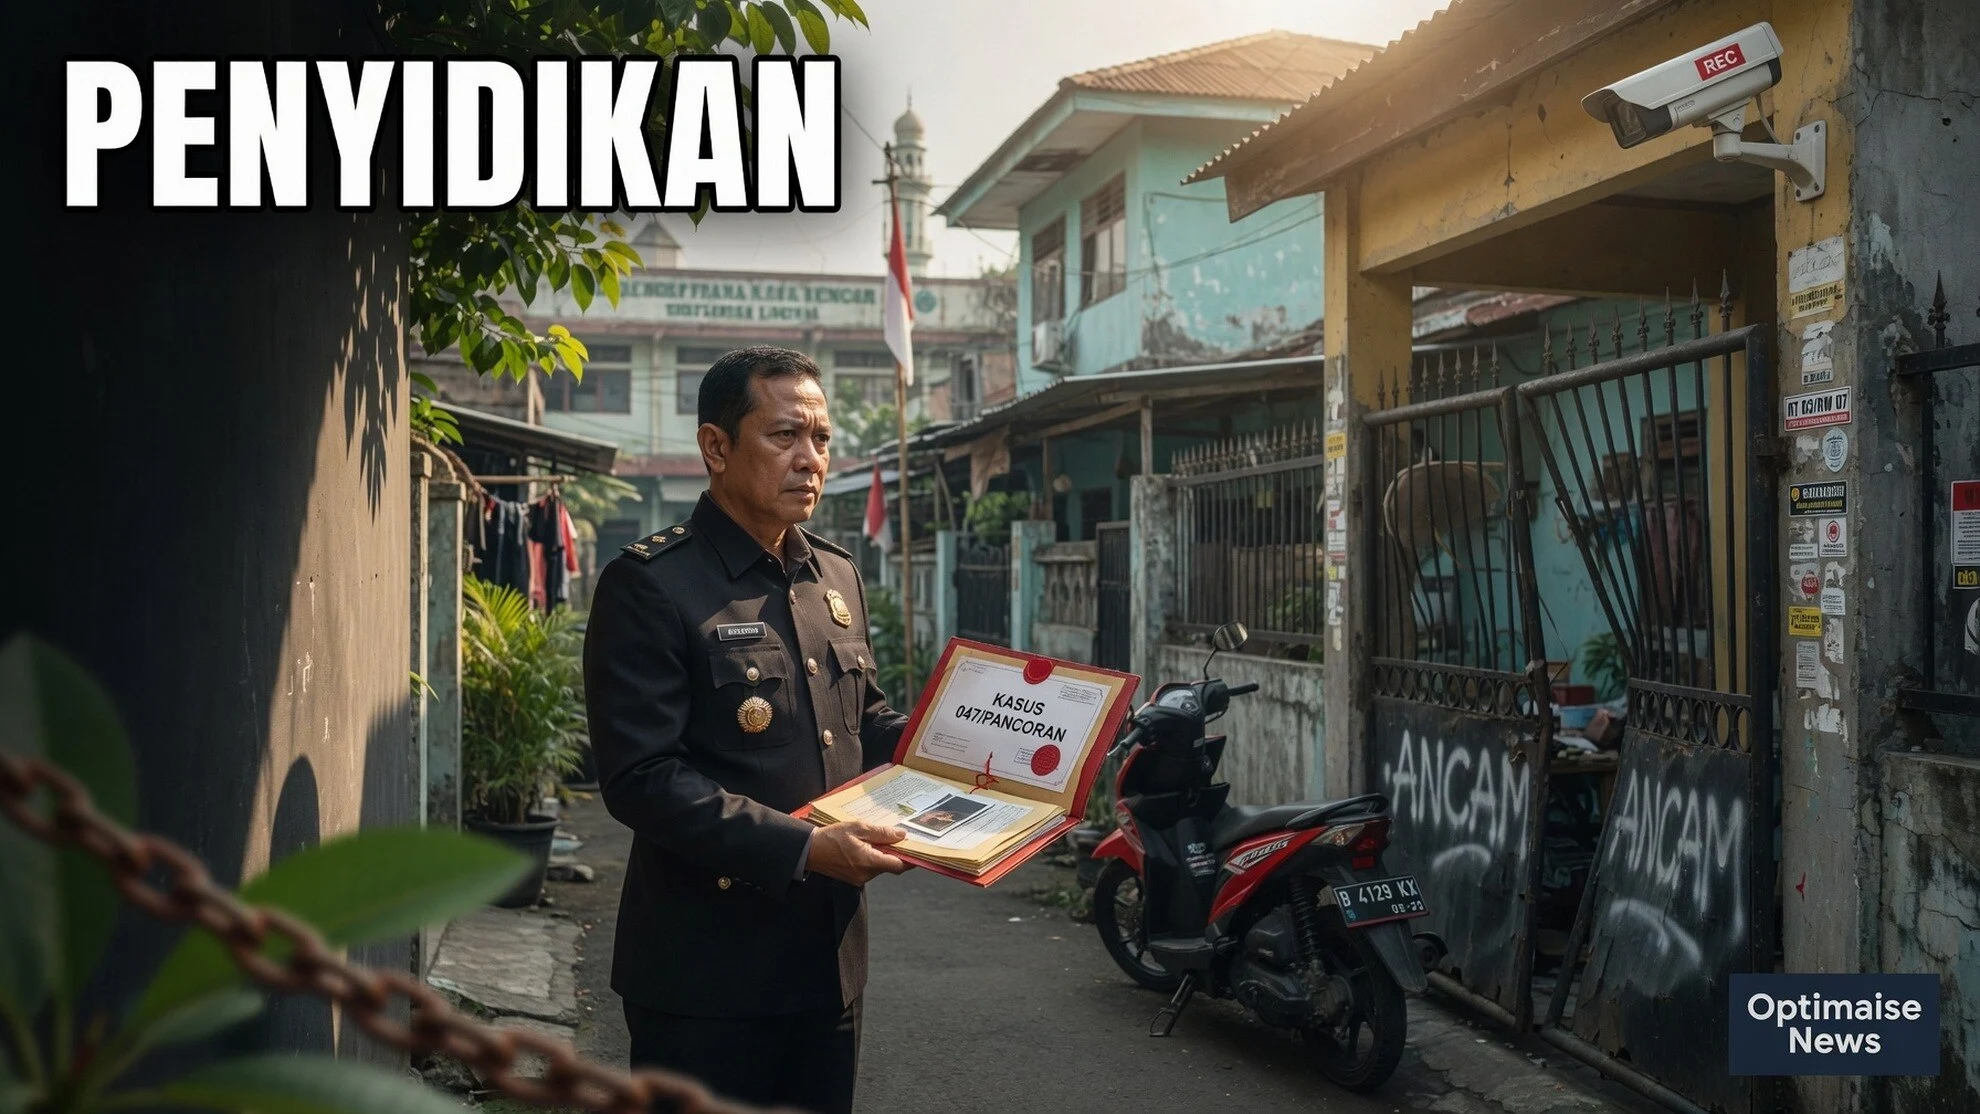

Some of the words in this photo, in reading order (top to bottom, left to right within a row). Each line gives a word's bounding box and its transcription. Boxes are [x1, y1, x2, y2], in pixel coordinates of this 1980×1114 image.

[1703, 50, 1738, 75] REC
[1836, 394, 1847, 410] 07
[992, 692, 1046, 716] KASUS
[955, 704, 1068, 743] 047/PANCORAN
[1392, 728, 1531, 864] ANCAM
[1606, 767, 1745, 937] ANCAM
[1339, 890, 1351, 907] B
[1359, 883, 1393, 904] 4129
[1396, 879, 1418, 897] KX
